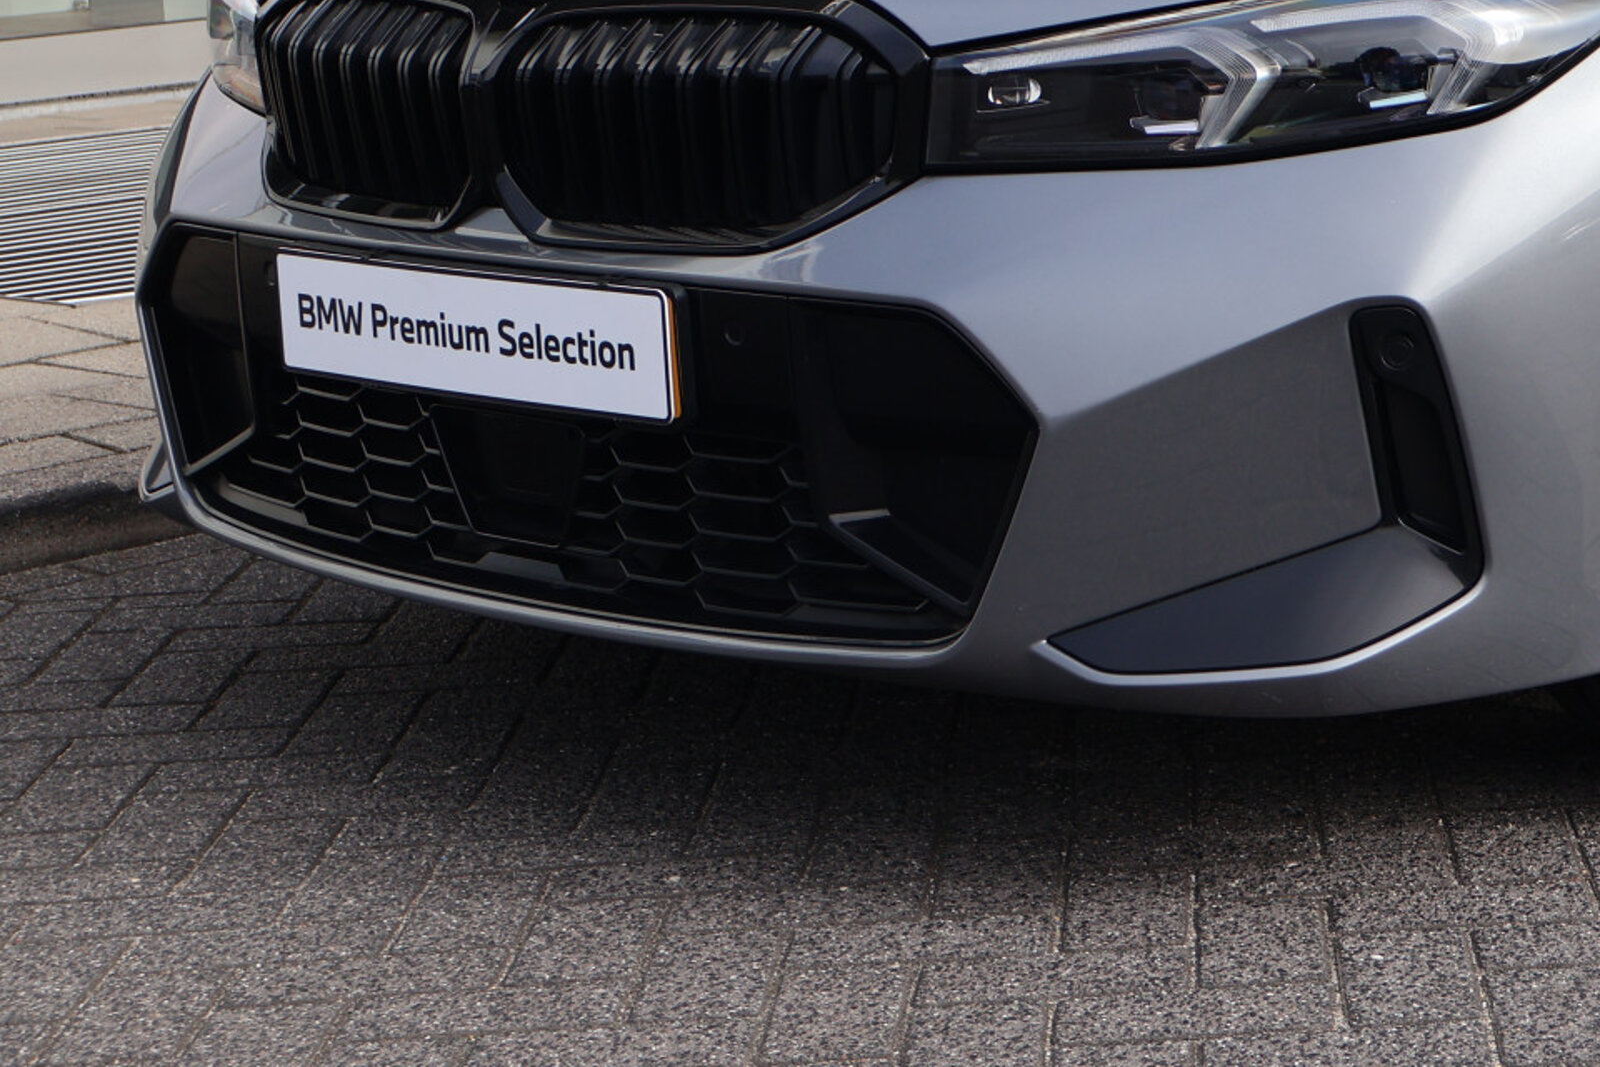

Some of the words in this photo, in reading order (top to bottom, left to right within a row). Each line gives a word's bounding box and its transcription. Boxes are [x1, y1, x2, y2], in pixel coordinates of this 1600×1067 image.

[298, 293, 363, 335] BMW
[370, 303, 490, 354] Premium
[499, 319, 637, 371] Selection
